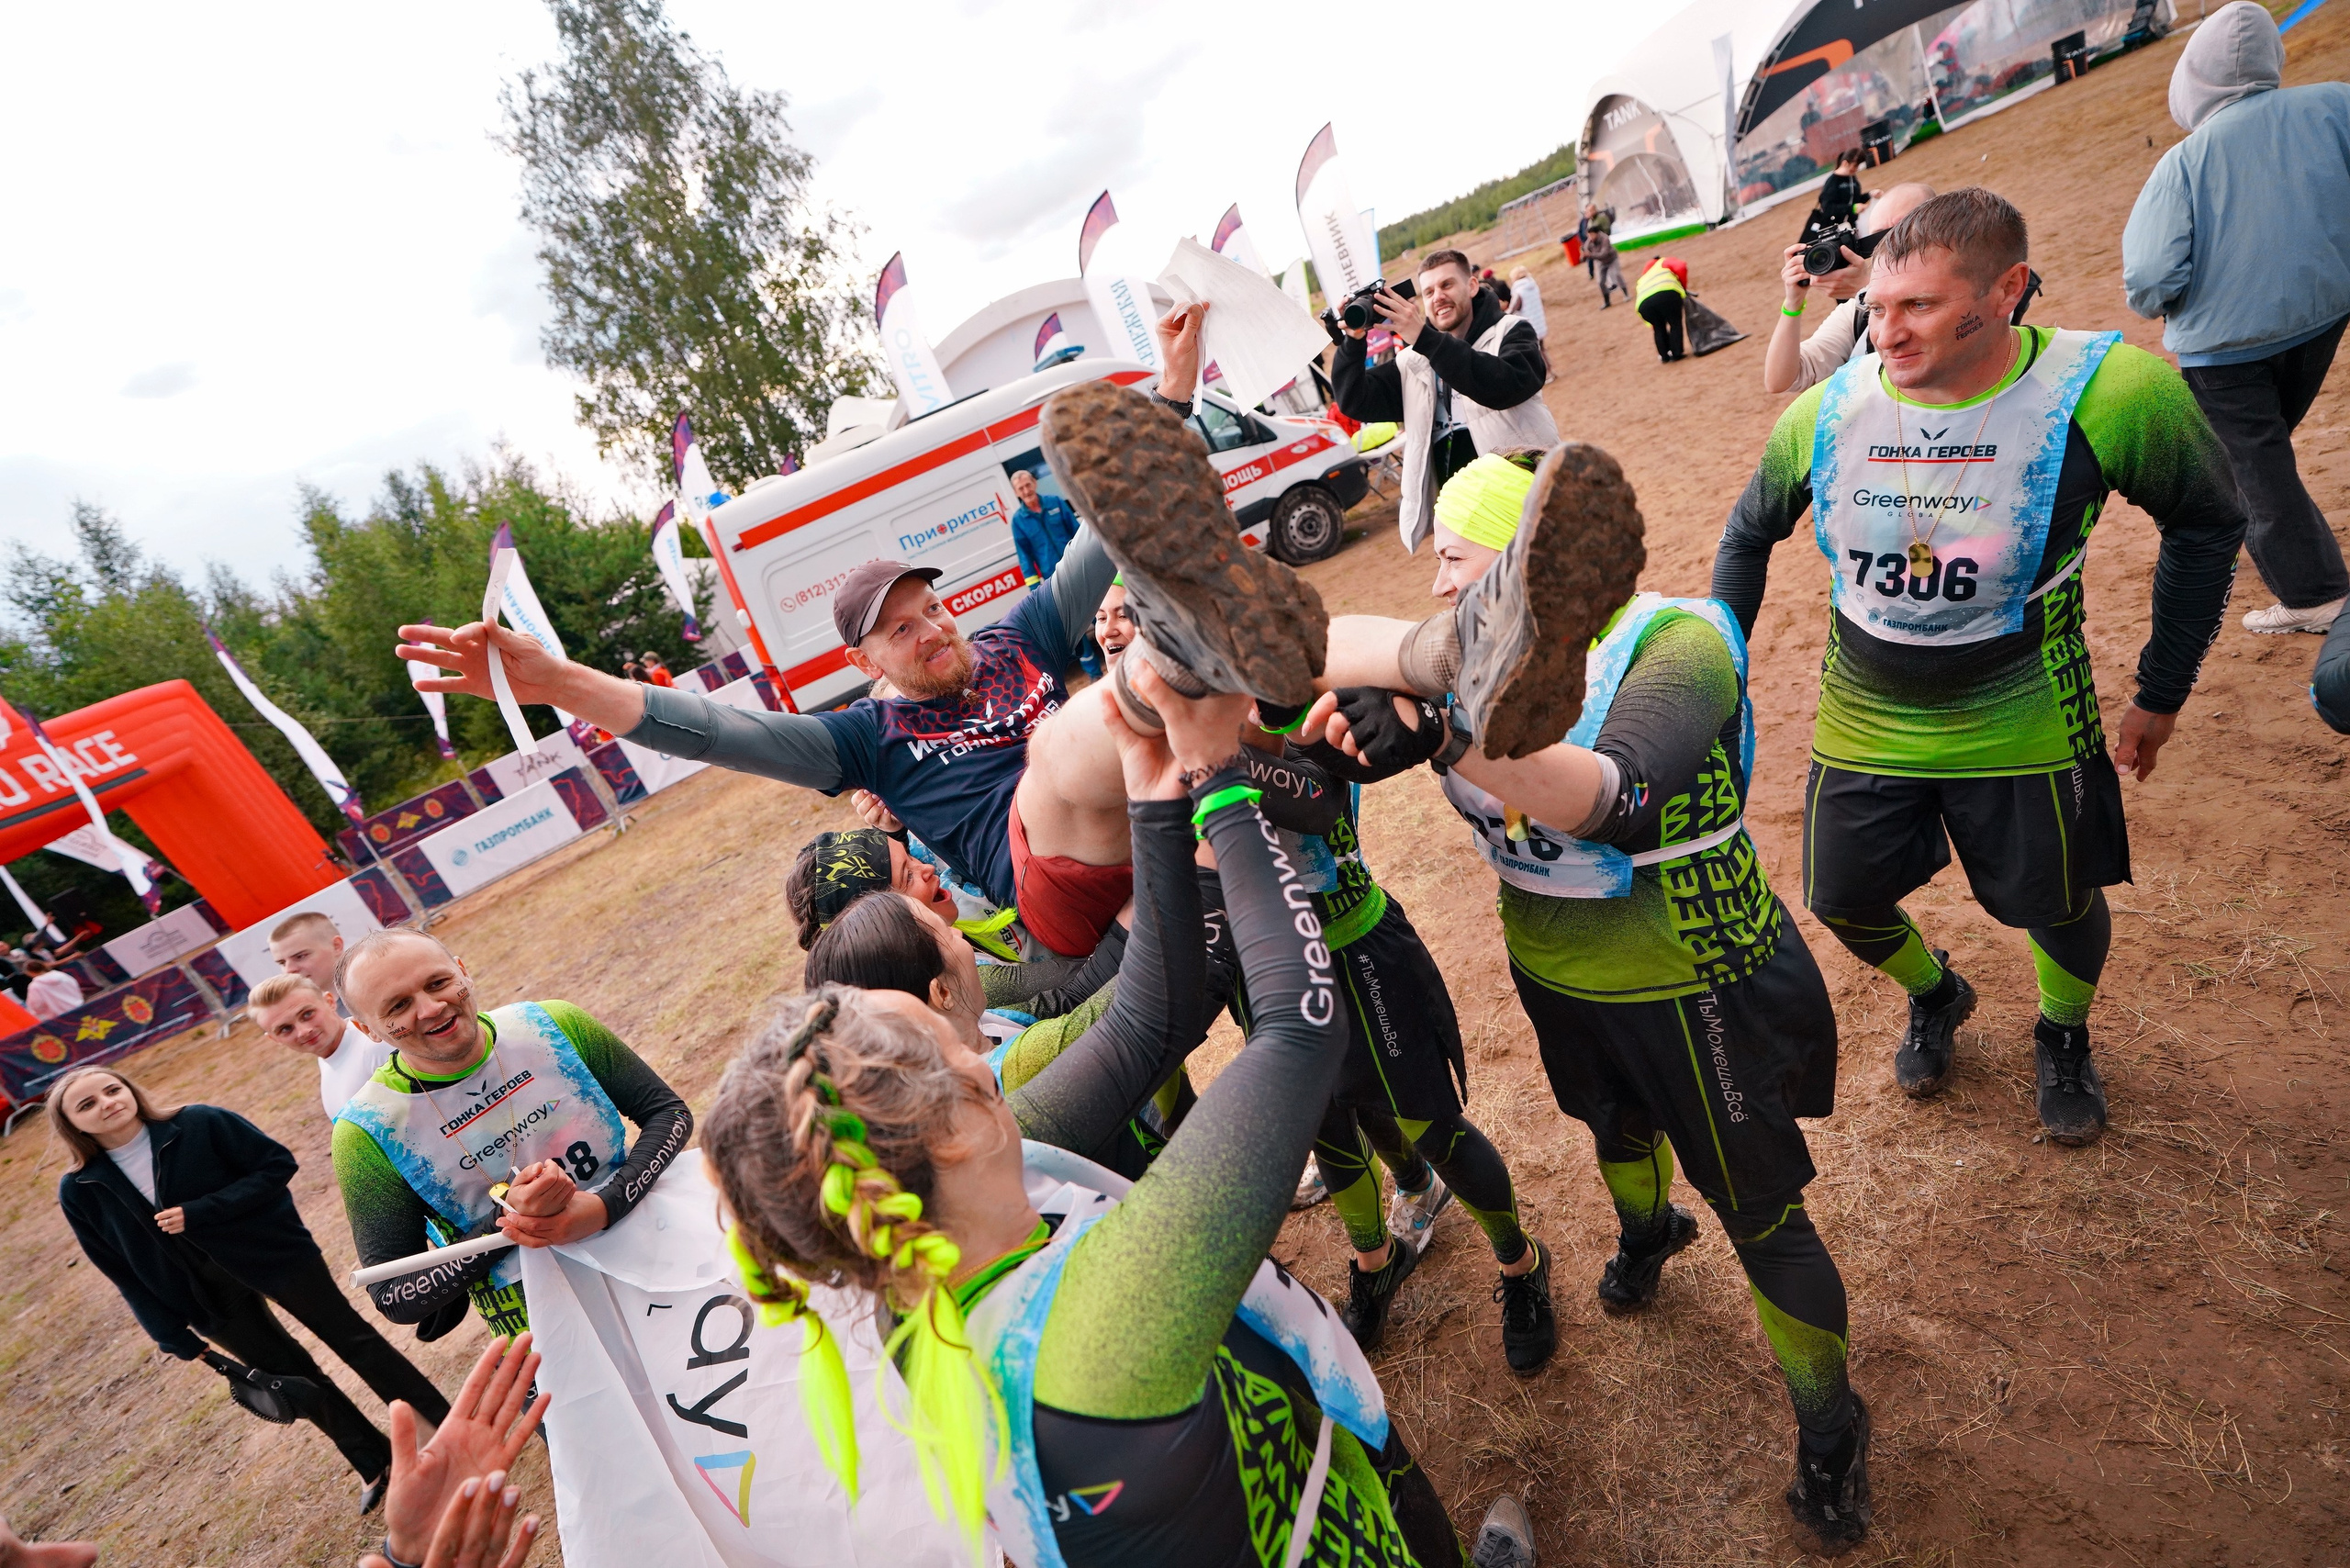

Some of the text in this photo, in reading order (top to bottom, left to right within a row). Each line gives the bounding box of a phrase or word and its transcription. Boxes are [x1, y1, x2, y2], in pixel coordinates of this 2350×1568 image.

[1603, 97, 1642, 131] TANK
[1955, 315, 1980, 332] ГОНКА
[1956, 321, 1984, 341] ГЕРОЕВ
[1869, 444, 1998, 458] ГОНКА ГЕРОЕВ
[1852, 488, 1975, 514] Greenway
[899, 499, 996, 551] Приоритет
[951, 573, 1017, 612] СКОРАЯ
[1849, 548, 1979, 602] 7306
[795, 583, 826, 607] (812)
[1883, 618, 1948, 633] ГАЗПРОМБАНК
[1010, 699, 1062, 737] ГЕРОЕ
[17, 730, 139, 793] RACE
[474, 807, 554, 853] ГАЗПРОМБАНК
[1499, 854, 1550, 878] ГАЗПРОМБАНК
[1246, 799, 1335, 1027] Greenwa
[1358, 954, 1403, 1058] #ТыМожешьВсё
[439, 1070, 532, 1136] ГОНКА ГЕРОЕВ
[459, 1103, 548, 1170] Greenway
[498, 1127, 538, 1159] GLOBAL
[625, 1114, 688, 1203] Greenway
[382, 1250, 488, 1306] Greenwa
[420, 1268, 477, 1305] GLOBAL
[666, 1294, 755, 1439] ay
